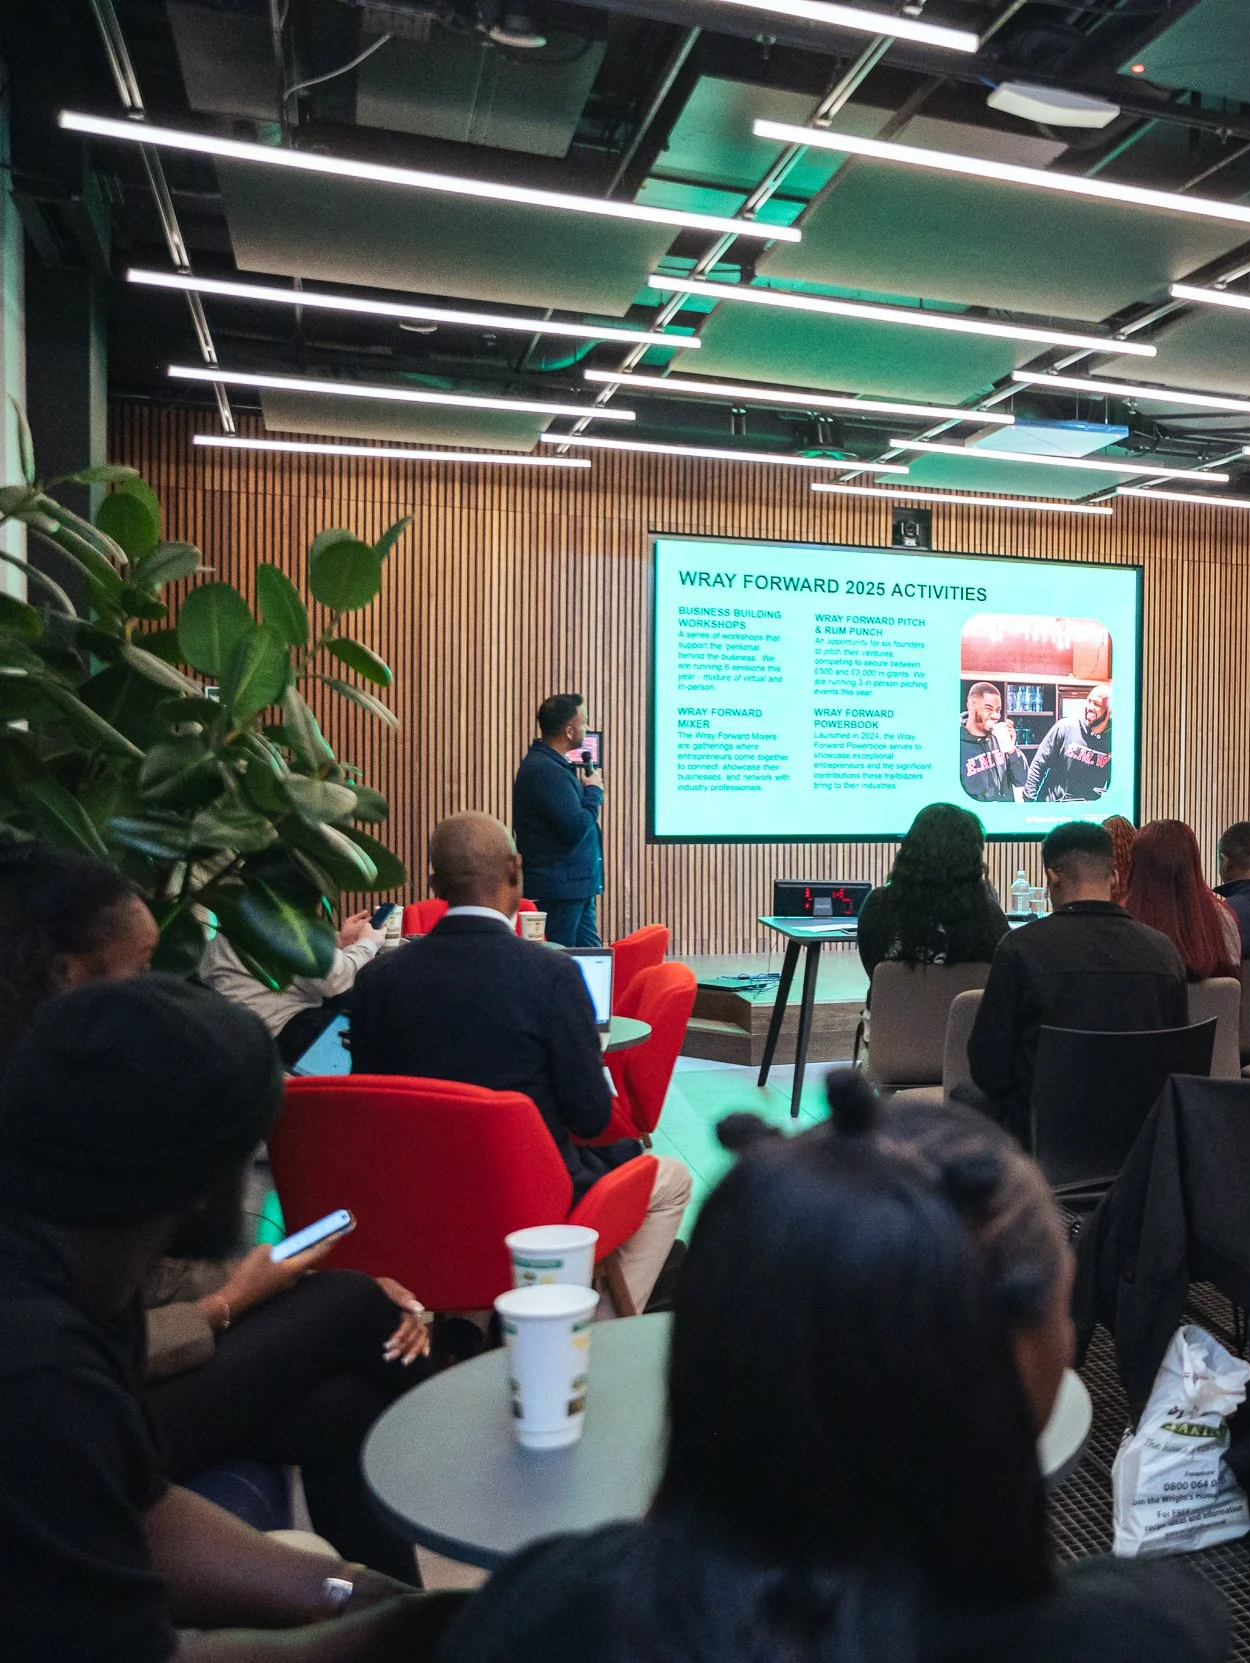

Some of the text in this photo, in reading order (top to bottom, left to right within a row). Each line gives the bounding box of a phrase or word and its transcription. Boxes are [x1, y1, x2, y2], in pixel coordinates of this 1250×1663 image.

[680, 571, 987, 601] WRAY FORWARD 2025 ACTIVITIES
[679, 607, 781, 618] BUSINESS BUILDING
[679, 619, 746, 629] WORKSHOPS
[815, 614, 926, 626] WRAY FORWARD PITCH
[825, 626, 846, 634] RUM
[850, 628, 883, 636] PUNCH
[722, 633, 763, 641] workshops
[829, 679, 856, 687] running
[900, 681, 928, 689] pitching
[678, 708, 762, 717] WRAY FORWARD
[814, 708, 894, 718] WRAY FORWARD
[678, 720, 710, 728] MIXER
[814, 720, 879, 728] POWERBOOK
[695, 732, 715, 741] Wray
[718, 732, 749, 740] Forward
[897, 733, 915, 741] Wray
[693, 743, 733, 751] gatherings
[1164, 1482, 1188, 1491] 0800
[1203, 1505, 1243, 1519] information
